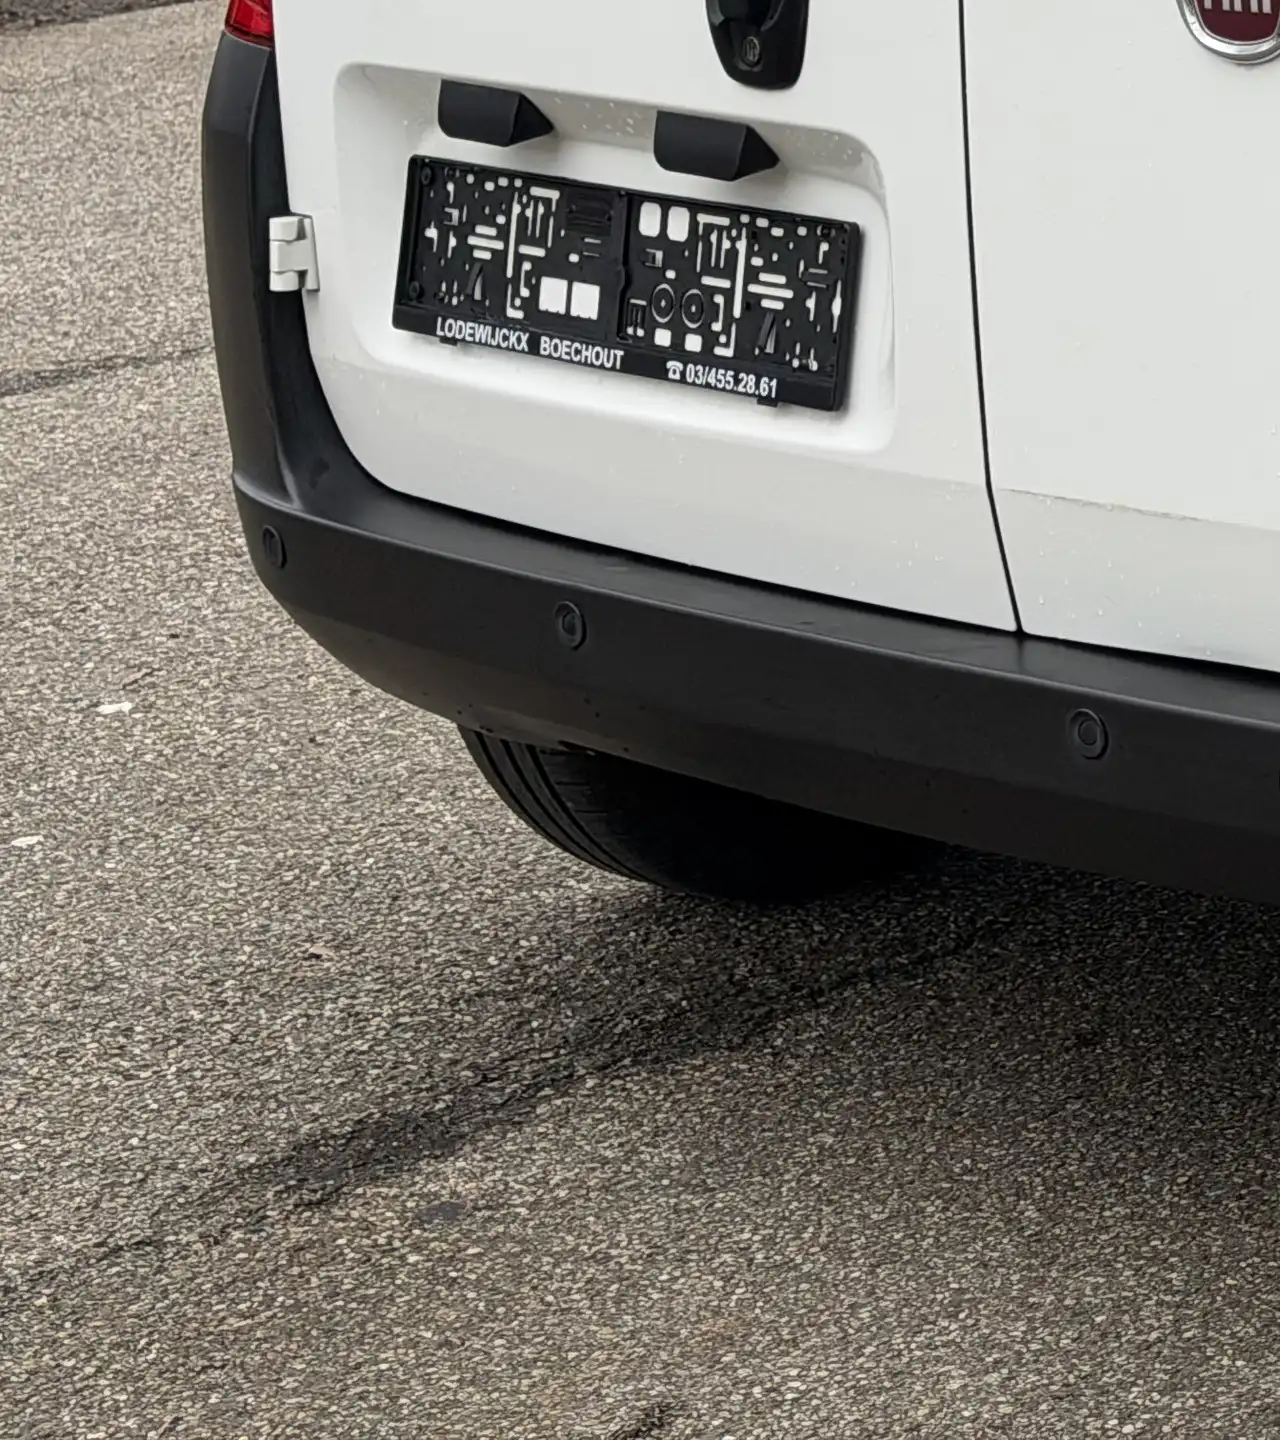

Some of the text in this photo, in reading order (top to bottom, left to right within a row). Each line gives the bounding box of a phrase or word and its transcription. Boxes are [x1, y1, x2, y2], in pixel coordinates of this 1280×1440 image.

[436, 316, 624, 370] LODEWIJCKX BOECHOUT
[685, 366, 778, 399] 03/455.28.61
